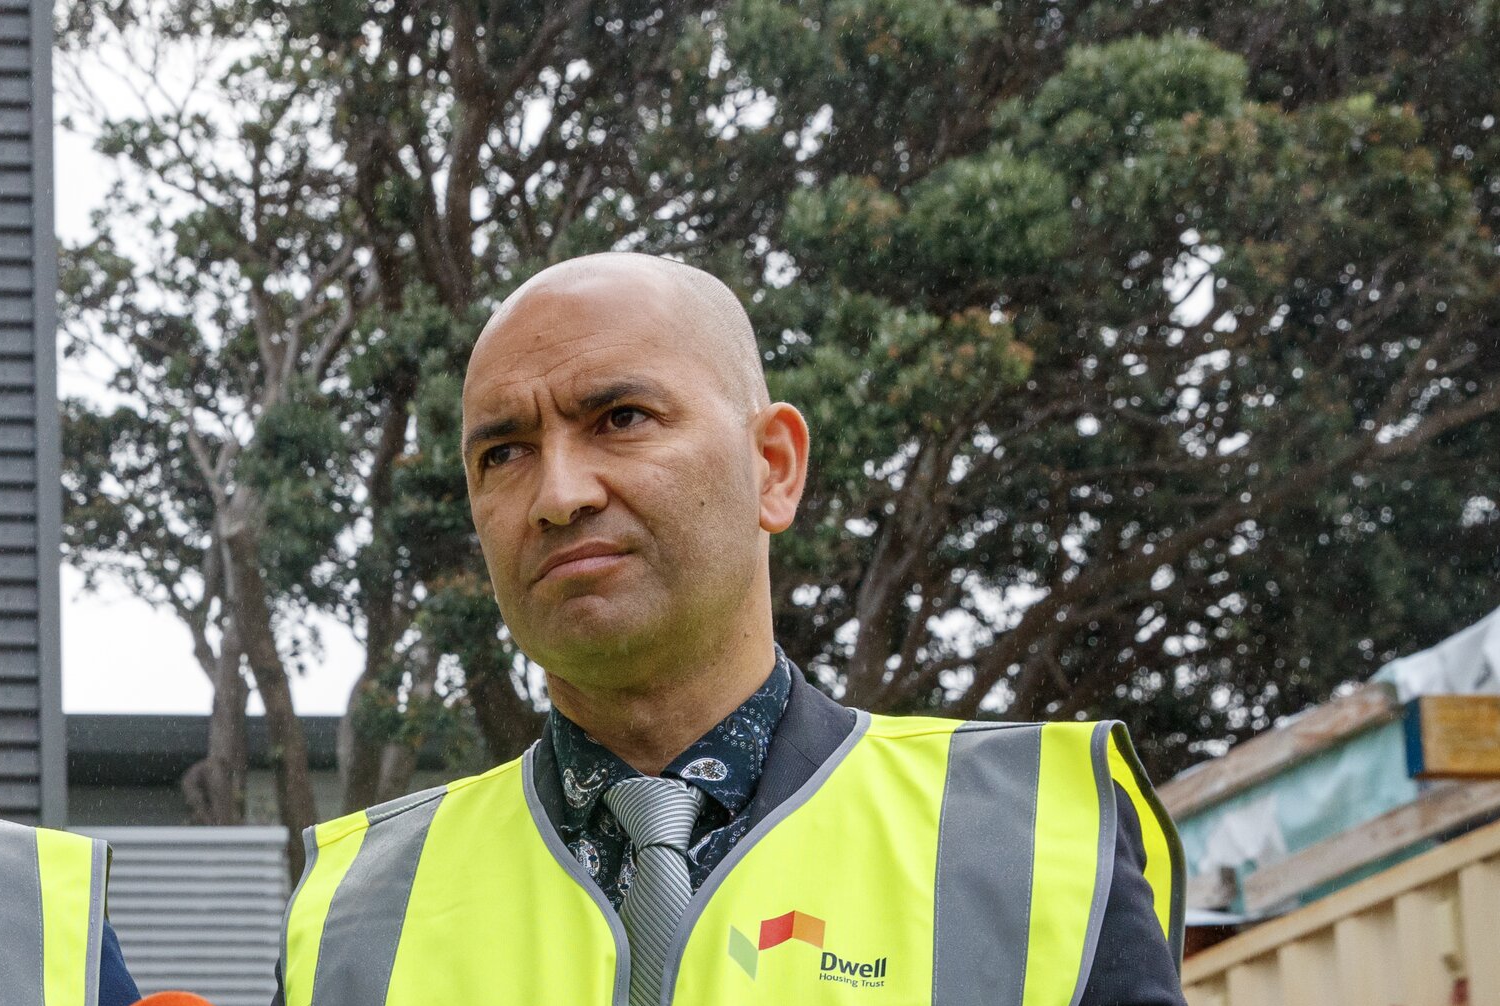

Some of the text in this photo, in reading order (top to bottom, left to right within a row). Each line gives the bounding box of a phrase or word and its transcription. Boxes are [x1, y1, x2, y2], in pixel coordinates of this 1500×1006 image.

[820, 951, 887, 978] Dwell
[819, 972, 885, 988] Housing Trust
